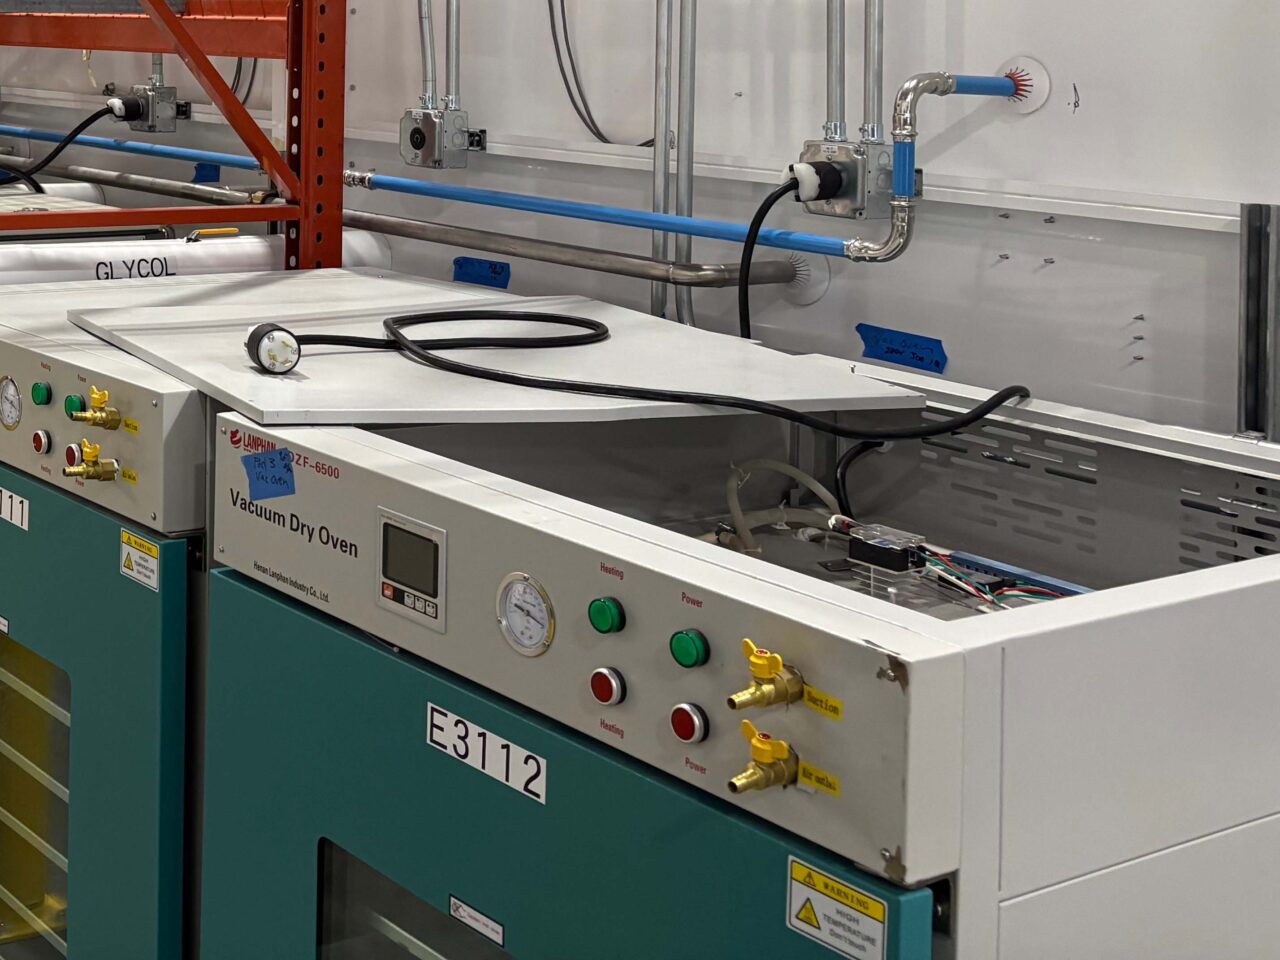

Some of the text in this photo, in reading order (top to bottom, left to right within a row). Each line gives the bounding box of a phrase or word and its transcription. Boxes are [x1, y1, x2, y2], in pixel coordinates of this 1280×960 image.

[95, 257, 176, 280] GLYCOL
[243, 432, 276, 452] LANPHAN
[230, 488, 358, 558] Vacuum Dry Oven
[253, 561, 268, 576] Henan
[269, 567, 289, 587] Lanphan
[289, 576, 309, 596] Industry
[600, 562, 624, 581] Heating
[681, 592, 703, 608] Power
[600, 718, 624, 739] Heating
[429, 706, 542, 800] E3112
[685, 757, 707, 775] Power
[823, 881, 869, 910] WARNING
[836, 908, 859, 925] HIGH
